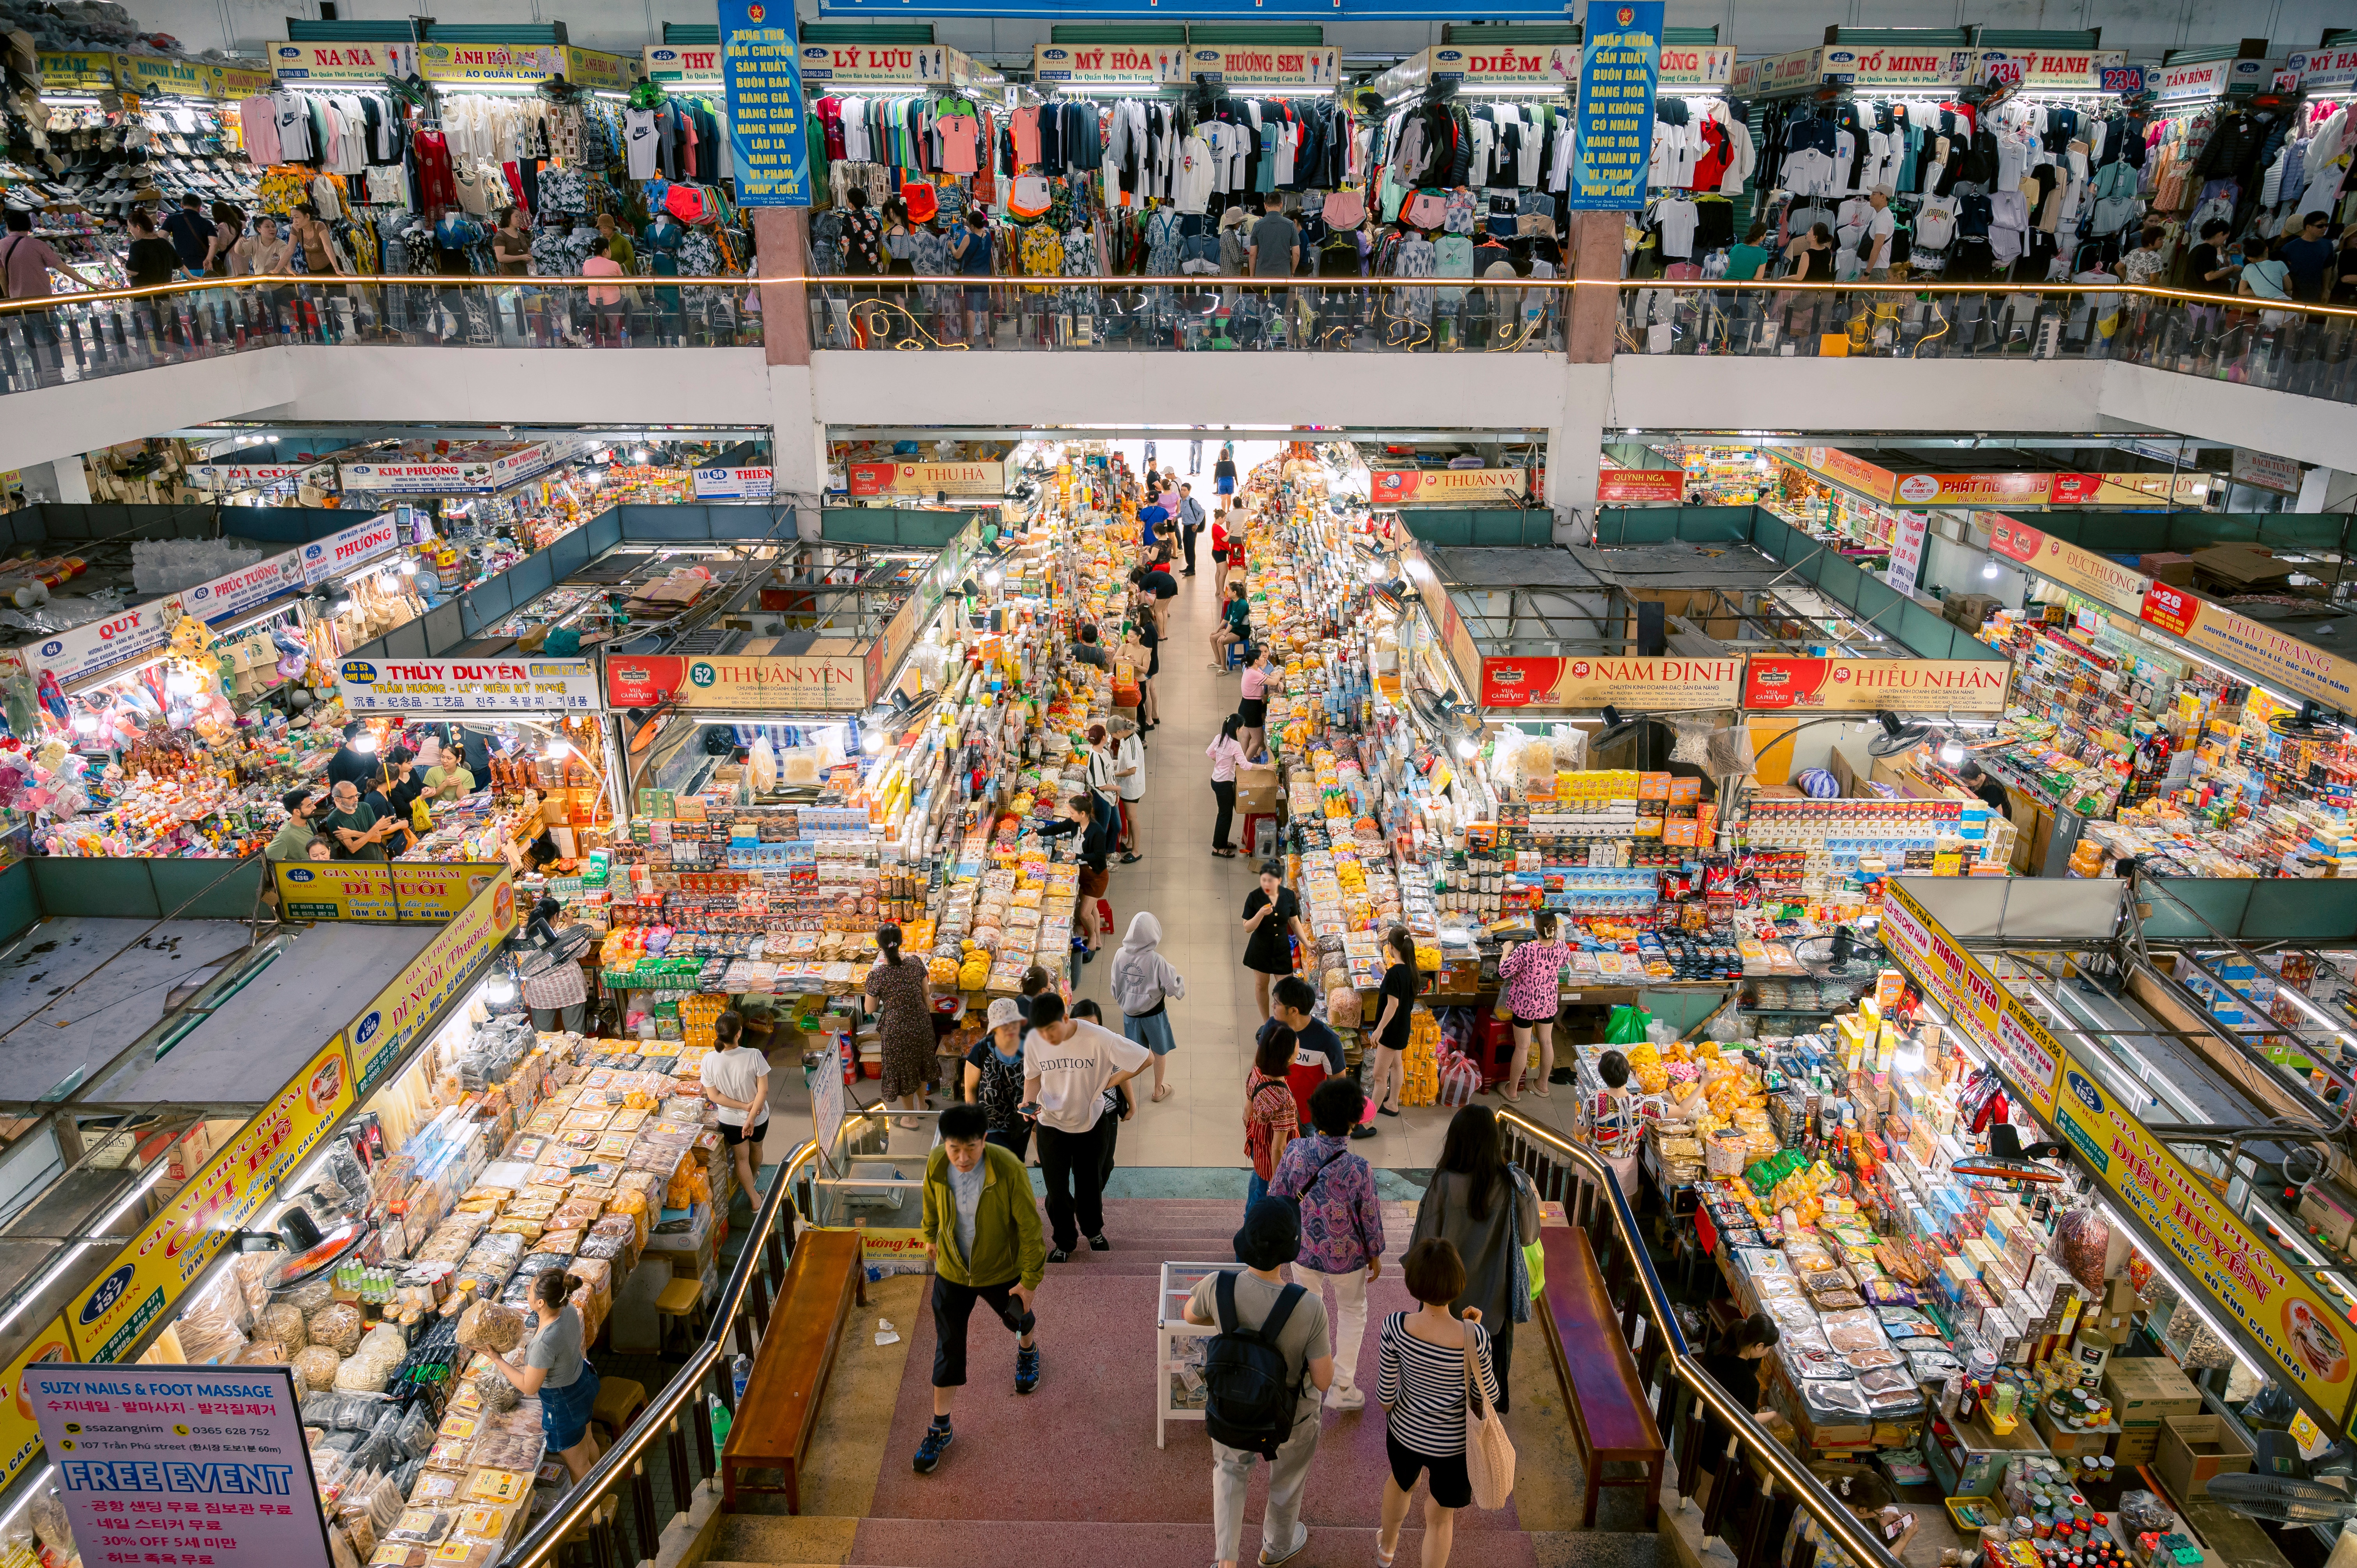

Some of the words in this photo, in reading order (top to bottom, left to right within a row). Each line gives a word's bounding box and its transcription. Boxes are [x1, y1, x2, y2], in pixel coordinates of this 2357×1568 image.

[732, 30, 760, 41] TÀNG
[765, 29, 784, 41] TRỮ
[314, 49, 343, 65] NA
[345, 49, 376, 66] NA
[728, 46, 749, 57] VẬN
[753, 44, 793, 56] CHUYỂN
[832, 46, 862, 68] LÝ
[868, 48, 913, 72] LỰU
[1074, 48, 1105, 70] MỸ
[1111, 47, 1153, 70] HÒA
[1224, 51, 1274, 72] HƯƠNG
[1277, 54, 1304, 72] SEN
[1468, 48, 1542, 73] DIỄM
[1857, 49, 1885, 72] TỐ
[1886, 57, 1939, 72] MINH
[2040, 57, 2090, 77] HẠNH
[466, 69, 482, 78] ÁO
[517, 71, 546, 79] LANH
[1990, 63, 2020, 82] 234
[2104, 70, 2140, 90] 234
[2166, 67, 2187, 87] TẤN
[2188, 68, 2213, 85] BÌNH
[284, 112, 295, 121] NIKE
[378, 468, 403, 477] KIM
[405, 465, 459, 477] PHƯỢNG
[2252, 457, 2271, 468] BẠCH
[712, 470, 724, 479] 56
[924, 468, 961, 481] THU
[963, 465, 986, 480] HÀ
[1442, 473, 1498, 487] THUẬN
[1496, 471, 1518, 486] VỸ
[1613, 473, 1645, 484] QUỲNH
[335, 528, 391, 561] PHƯƠNG
[333, 561, 352, 572] Souvenir
[357, 548, 379, 562] Handmade
[380, 542, 396, 552] Product
[214, 576, 243, 597] PHÚC
[244, 563, 279, 586] TƯỜNG
[2067, 551, 2089, 571] ĐỨC
[2090, 562, 2135, 592] THƯƠNG
[197, 589, 207, 598] 63
[2161, 591, 2182, 608] 26
[47, 645, 58, 654] 64
[2225, 615, 2264, 642] THU
[2267, 633, 2332, 673] TRANG
[348, 663, 358, 671] LÔ:
[386, 661, 446, 680] THÙY
[453, 662, 528, 680] DUYÊN
[694, 667, 711, 683] 52
[717, 663, 804, 686] THUẬN
[806, 659, 853, 683] YẾN
[1575, 663, 1587, 673] 36
[1594, 661, 1657, 681] NAM
[1661, 661, 1735, 684] ĐỊNH
[1836, 669, 1848, 678] 35
[1854, 662, 1923, 687] HIẾU
[1923, 666, 2004, 689] NHÂN
[345, 673, 358, 682] CHỢ
[360, 672, 375, 680] HÀN
[371, 681, 402, 694] TRẦM
[407, 682, 447, 694] HƯƠNG
[458, 683, 481, 694] LƯU
[484, 683, 510, 695] NIỆM
[515, 682, 531, 694] MỸ
[536, 682, 566, 694] NGHỆ
[353, 696, 376, 707] 沉香
[388, 696, 422, 707] 纪念品
[433, 696, 465, 707] 工艺品
[1885, 899, 1902, 923] LÔ:153
[1902, 916, 1915, 936] CHỢ
[1914, 931, 1928, 949] HÀN
[1932, 933, 1965, 975] THANH
[392, 996, 410, 1029] DÌ
[410, 962, 445, 1009] NUÔI
[445, 913, 493, 973] (Thương)
[2008, 1000, 2018, 1015] ĐT:
[2019, 1012, 2035, 1033] 0905
[2035, 1028, 2046, 1045] 215
[2047, 1038, 2061, 1058] 558
[1039, 1058, 1095, 1071] EDITION
[2075, 1083, 2094, 1107] 152
[2110, 1132, 2171, 1203] DIỆU
[2171, 1200, 2271, 1305] HUYỀN
[2122, 1171, 2159, 1214] Chuyên
[2161, 1213, 2186, 1241] bán
[2189, 1241, 2214, 1267] đặc
[2214, 1266, 2244, 1299] sản:
[95, 1280, 123, 1314] 137
[85, 1312, 112, 1344] CHỢ
[115, 1282, 141, 1314] HÀN
[41, 1381, 81, 1394] SUZY
[85, 1382, 131, 1396] NAILS
[135, 1383, 149, 1396] &
[151, 1384, 193, 1397] FOOT
[197, 1385, 274, 1398] MASSAGE
[48, 1400, 110, 1413] 수지네일
[123, 1400, 186, 1415] 발마사지
[198, 1402, 276, 1417] 발각질제거
[85, 1423, 164, 1434] ssazangnim
[193, 1426, 223, 1436] 0365
[226, 1427, 247, 1436] 628
[249, 1428, 270, 1436] 752
[81, 1441, 99, 1449] 107
[102, 1440, 126, 1450] Trần
[131, 1441, 151, 1450] Phú
[154, 1442, 186, 1451] street
[60, 1460, 163, 1492] FREE
[163, 1462, 293, 1495] EVENT
[97, 1518, 130, 1530] 네일
[134, 1519, 185, 1531] 스티커
[189, 1519, 223, 1531] 무료
[102, 1536, 136, 1547] 30%
[140, 1536, 168, 1548] OFF
[174, 1537, 200, 1549] 5세
[204, 1537, 237, 1549] 미만
